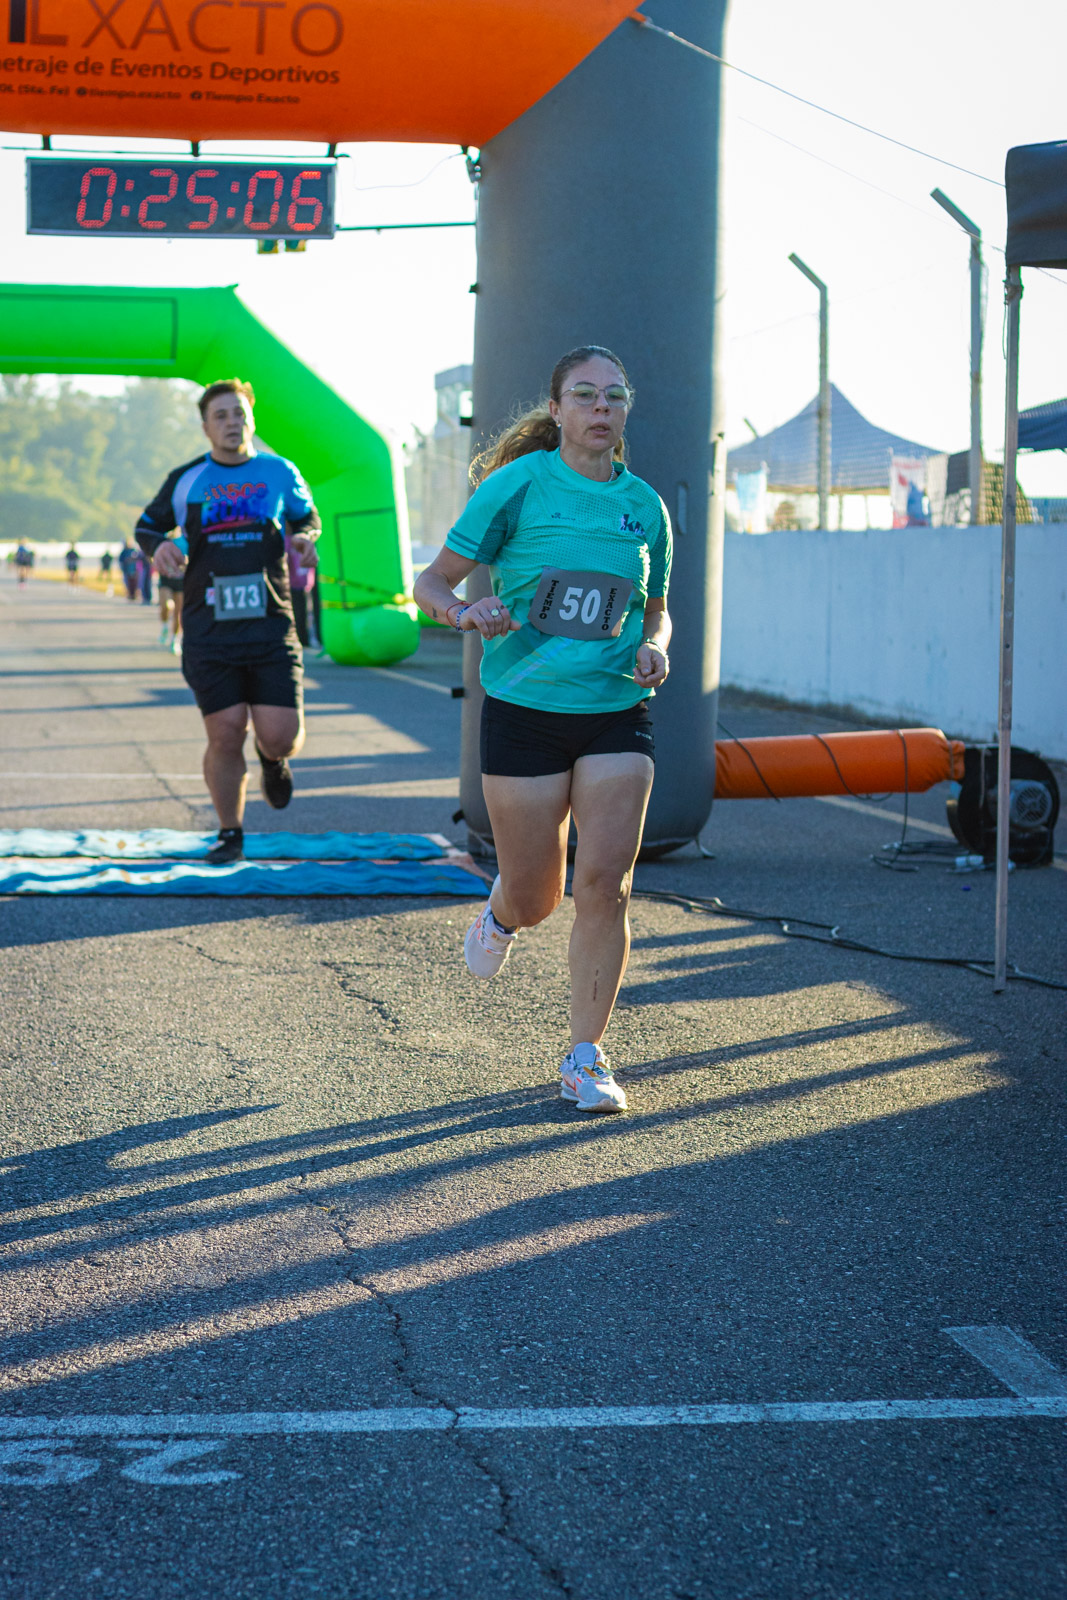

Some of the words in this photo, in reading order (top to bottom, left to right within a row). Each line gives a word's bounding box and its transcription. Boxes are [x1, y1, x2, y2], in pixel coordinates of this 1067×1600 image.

[0, 56, 69, 77] etraje
[73, 57, 105, 75] de
[111, 58, 204, 79] Eventos
[210, 62, 341, 85] Deportivos
[76, 167, 323, 231] 0:25:06
[223, 583, 261, 610] 173
[539, 579, 560, 620] TIEMPO
[558, 586, 602, 625] 50
[601, 587, 618, 631] EXACTO
